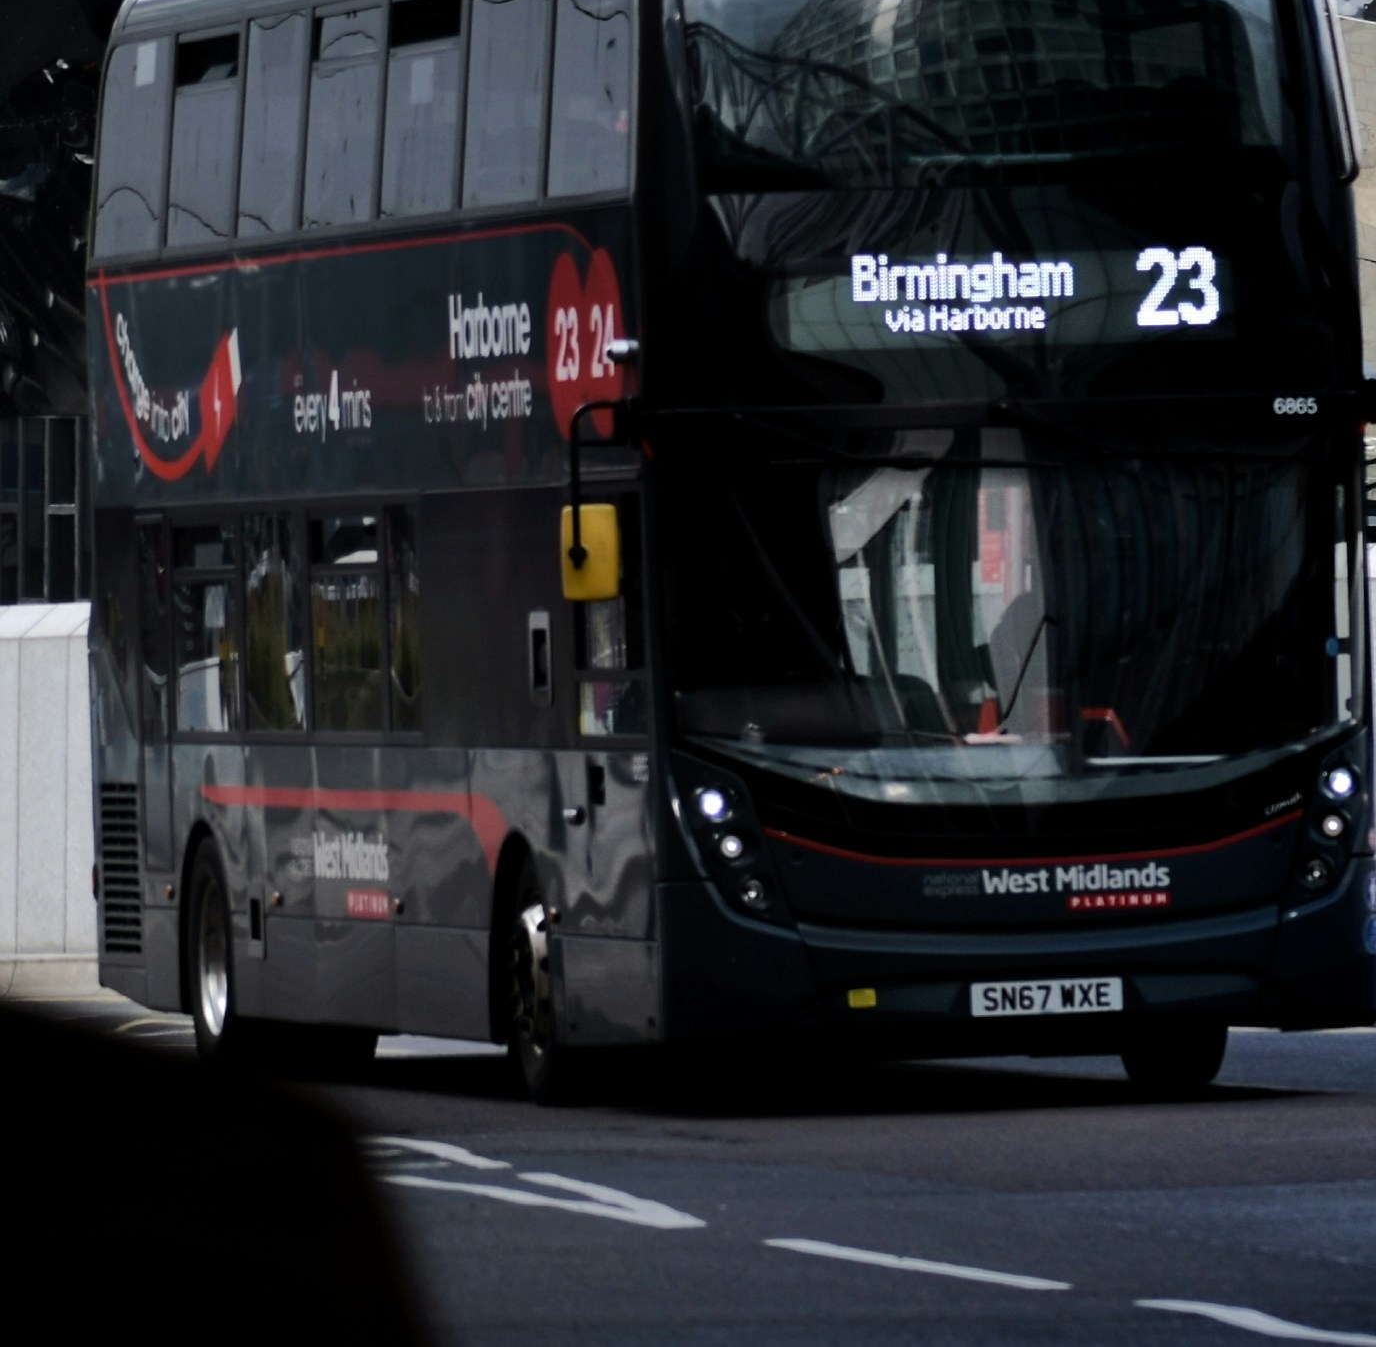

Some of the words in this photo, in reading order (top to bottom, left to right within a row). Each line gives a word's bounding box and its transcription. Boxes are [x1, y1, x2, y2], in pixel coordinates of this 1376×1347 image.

[851, 252, 1073, 303] Birmingham
[1136, 246, 1220, 326] 23
[885, 306, 926, 332] via
[928, 305, 1046, 331] Harborne
[448, 292, 531, 359] Harborne
[555, 306, 579, 381] 23
[591, 304, 615, 378] 24
[294, 394, 327, 444] every
[328, 370, 340, 430] 4
[342, 379, 372, 428] mins
[466, 372, 488, 430] city
[491, 368, 532, 419] centre
[1273, 398, 1318, 414] 6865
[982, 868, 1050, 894] West
[1056, 862, 1170, 891] Midlands
[1071, 893, 1167, 908] PLATINUM
[983, 984, 1051, 1012] SN67
[1060, 982, 1112, 1009] WXE
